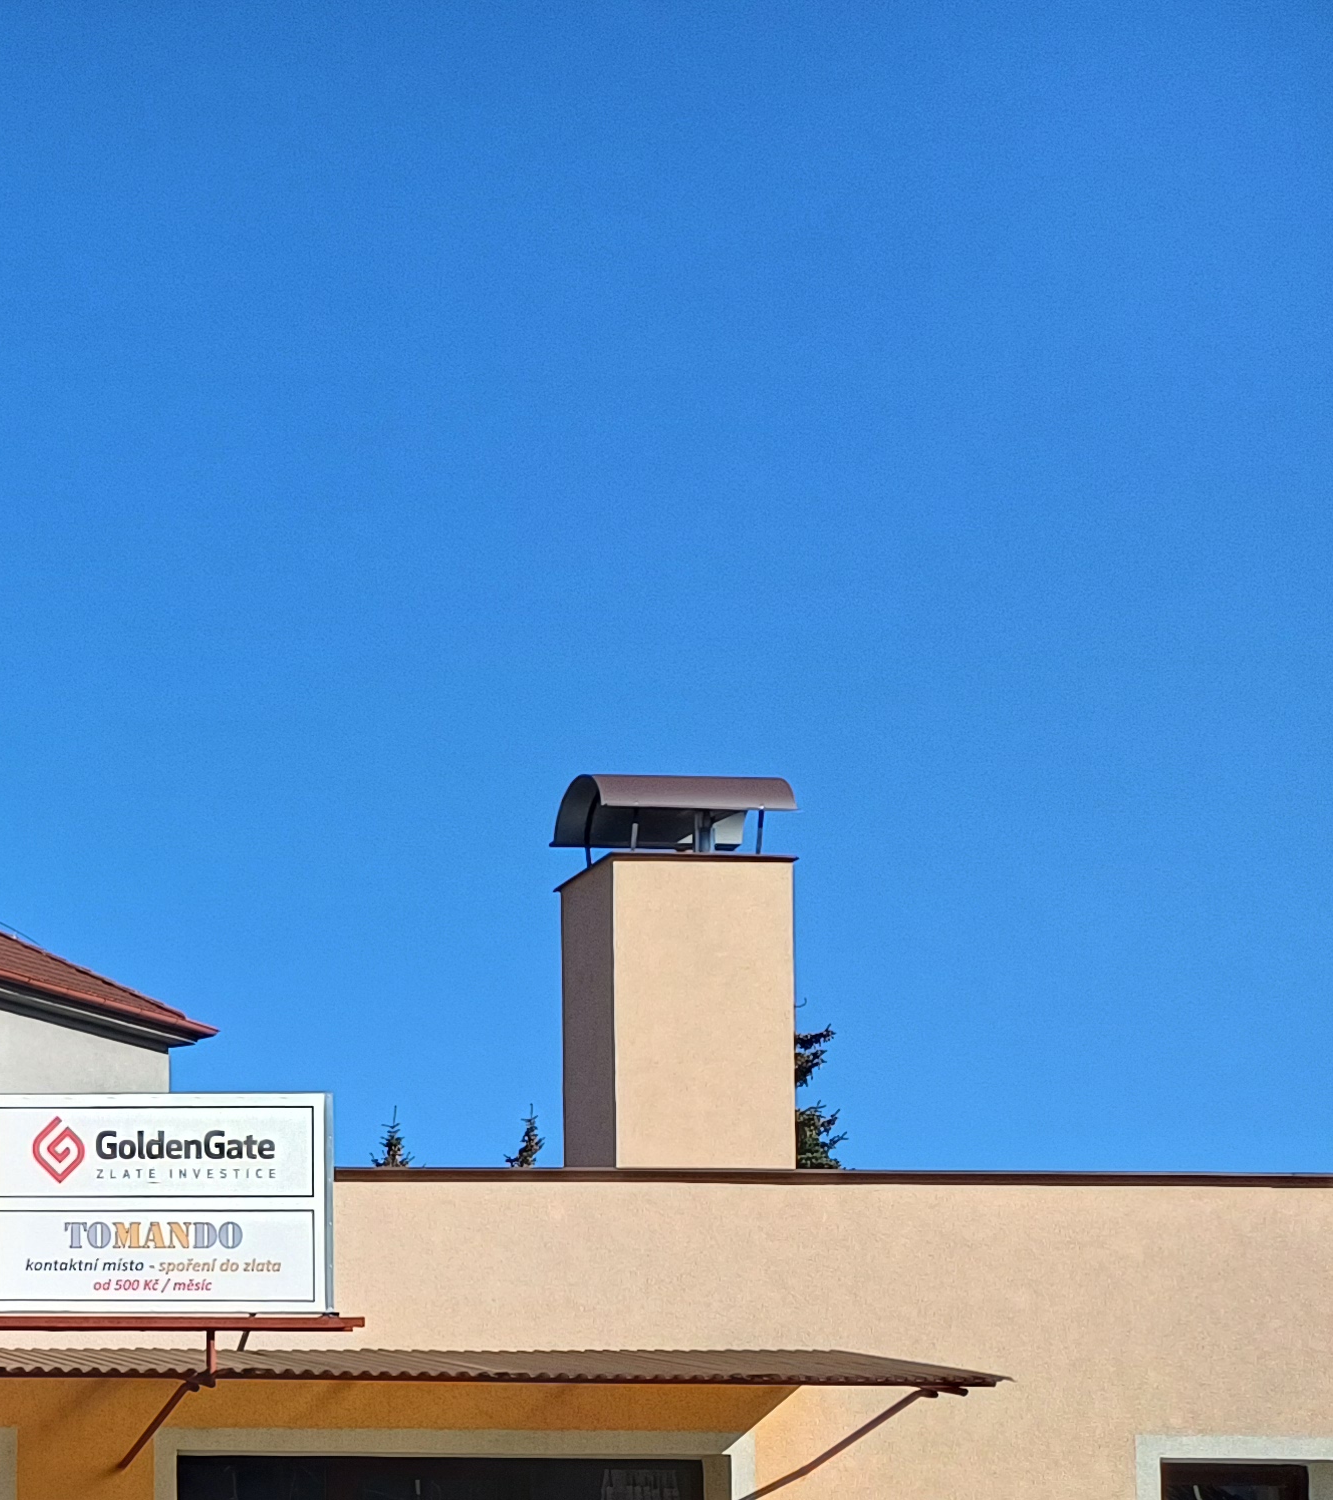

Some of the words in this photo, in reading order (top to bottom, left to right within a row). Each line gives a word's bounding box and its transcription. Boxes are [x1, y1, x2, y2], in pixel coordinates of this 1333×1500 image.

[95, 1129, 276, 1160] GoldenGate
[169, 1168, 277, 1180] INVESTICE
[64, 1221, 244, 1250] TOMANDO
[25, 1258, 99, 1273] kontaktní
[103, 1258, 145, 1273] místo
[158, 1258, 216, 1275] spoření
[219, 1258, 240, 1273] do
[243, 1258, 282, 1273] zlata
[93, 1279, 112, 1292] od
[114, 1279, 141, 1292] 500
[143, 1278, 159, 1292] Kč
[173, 1278, 213, 1292] měsíc
